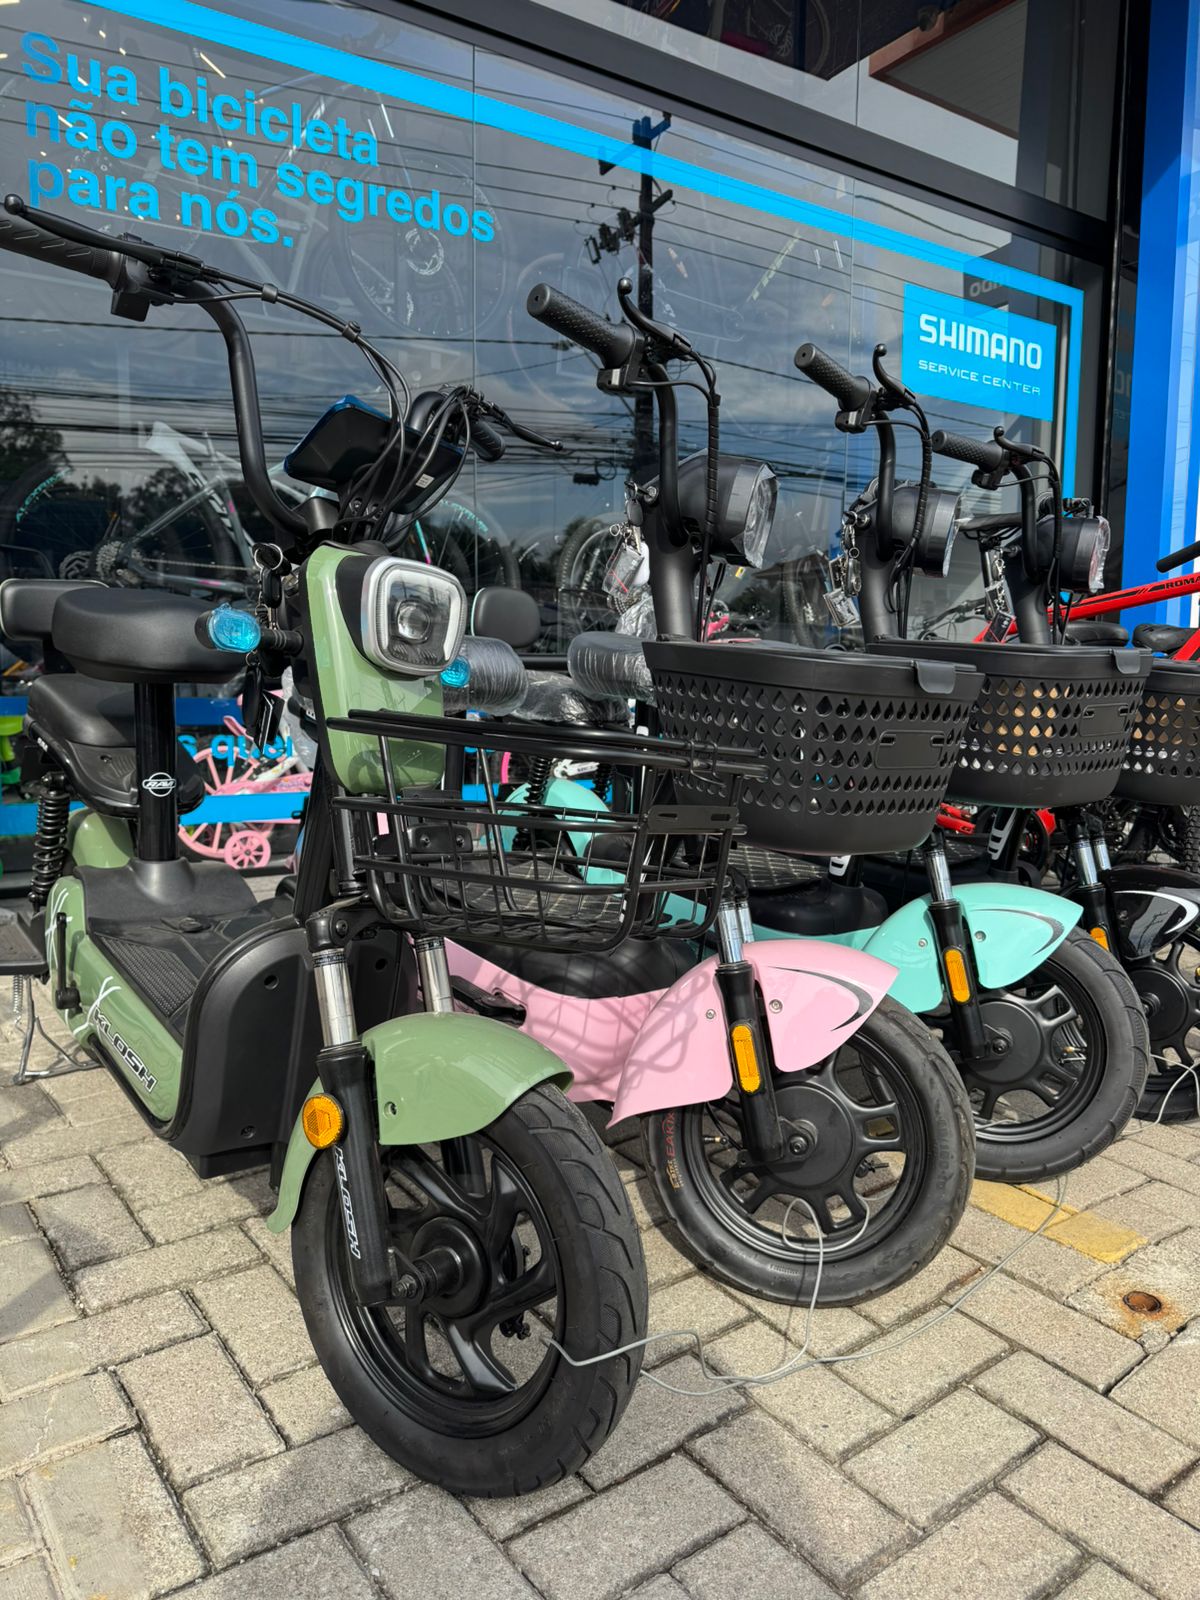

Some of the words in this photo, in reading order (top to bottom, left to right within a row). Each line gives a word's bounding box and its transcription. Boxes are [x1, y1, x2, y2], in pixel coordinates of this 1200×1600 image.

[20, 31, 139, 106] Sua
[158, 65, 380, 168] bicicleta
[26, 100, 138, 160] não
[155, 123, 259, 188] tem
[276, 161, 496, 243] segredos
[28, 158, 161, 221] para
[181, 189, 294, 248] nós.
[918, 360, 979, 382] SERVICE
[982, 375, 1040, 395] CENTER
[920, 313, 1042, 370] SHIMANO
[94, 1006, 157, 1092] KLOSH
[334, 1146, 361, 1260] KLOSH
